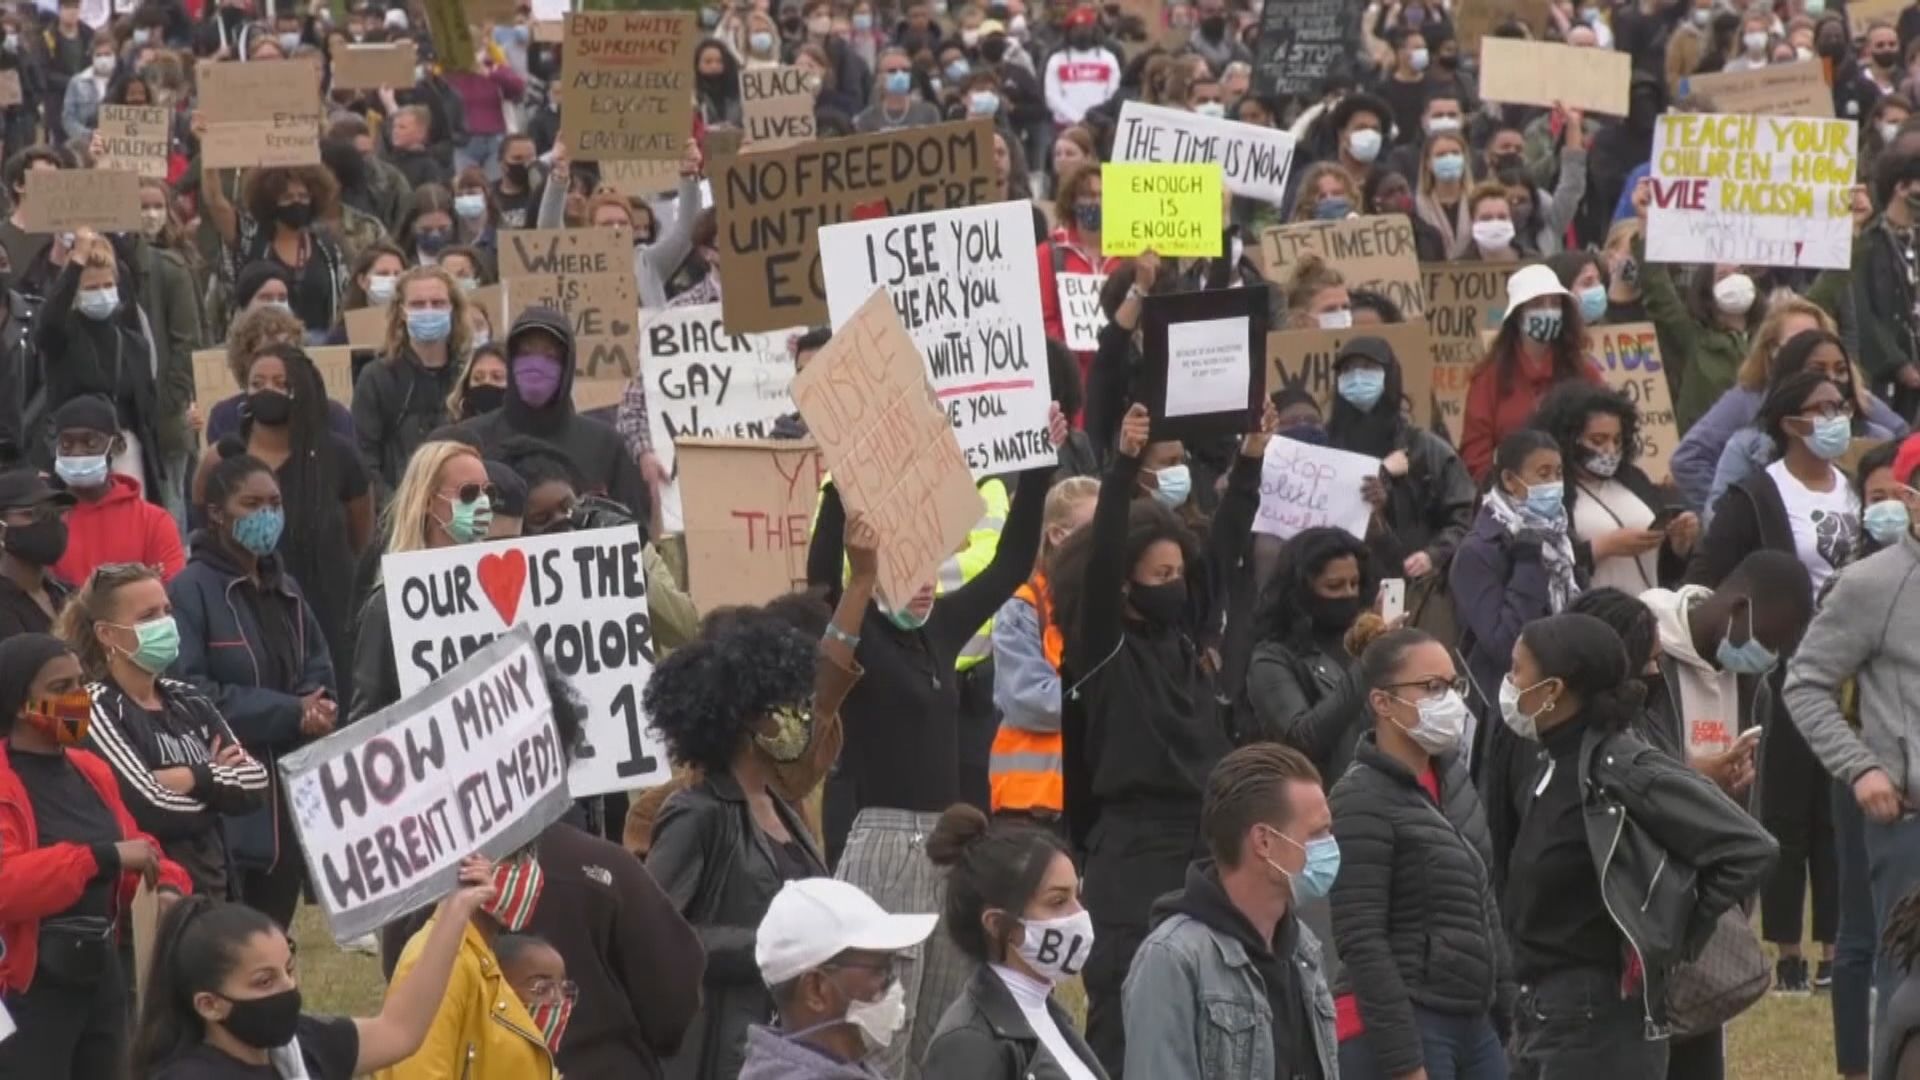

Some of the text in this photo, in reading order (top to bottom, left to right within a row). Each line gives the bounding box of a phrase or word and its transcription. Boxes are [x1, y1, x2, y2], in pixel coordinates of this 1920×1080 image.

[571, 15, 684, 35] END WHITE
[576, 38, 681, 55] SUPREMACY
[743, 72, 811, 101] BLACK
[105, 107, 164, 124] SILENCE
[125, 123, 138, 137] IS
[750, 116, 813, 140] LIVES
[101, 138, 168, 157] VIOLENCE
[1125, 117, 1293, 186] THE TIME IS NOW
[1661, 114, 1850, 156] TEACH YOUR
[726, 129, 978, 209] NO FREEDOM
[1131, 176, 1203, 194] ENOUGH
[1659, 150, 1855, 183] CHILDREN HOW
[1160, 199, 1179, 215] IS
[1648, 177, 1709, 211] VILE
[1720, 182, 1814, 217] RACISM
[1131, 220, 1202, 239] ENOUGH
[1319, 224, 1373, 260] TIME
[1374, 219, 1415, 254] FOR
[512, 236, 609, 273] WHERE
[866, 219, 1003, 285] I SEE YOU
[894, 276, 1001, 330] HEAR YOU
[1449, 271, 1498, 301] YOU
[1424, 304, 1477, 338] YOUR
[927, 323, 1029, 378] WITH YOU
[658, 363, 732, 406] GAY
[967, 394, 1009, 424] YOU
[993, 426, 1055, 463] MATTER
[1266, 447, 1337, 500] Stop
[731, 510, 807, 551] THE
[401, 542, 646, 620] OUR IS THE
[411, 612, 658, 683] SAM COLOR
[318, 716, 446, 829] HOW
[451, 654, 535, 751] MANY
[322, 796, 457, 909] WERENT
[456, 722, 560, 845] FILMED!
[1036, 929, 1084, 975] BL
